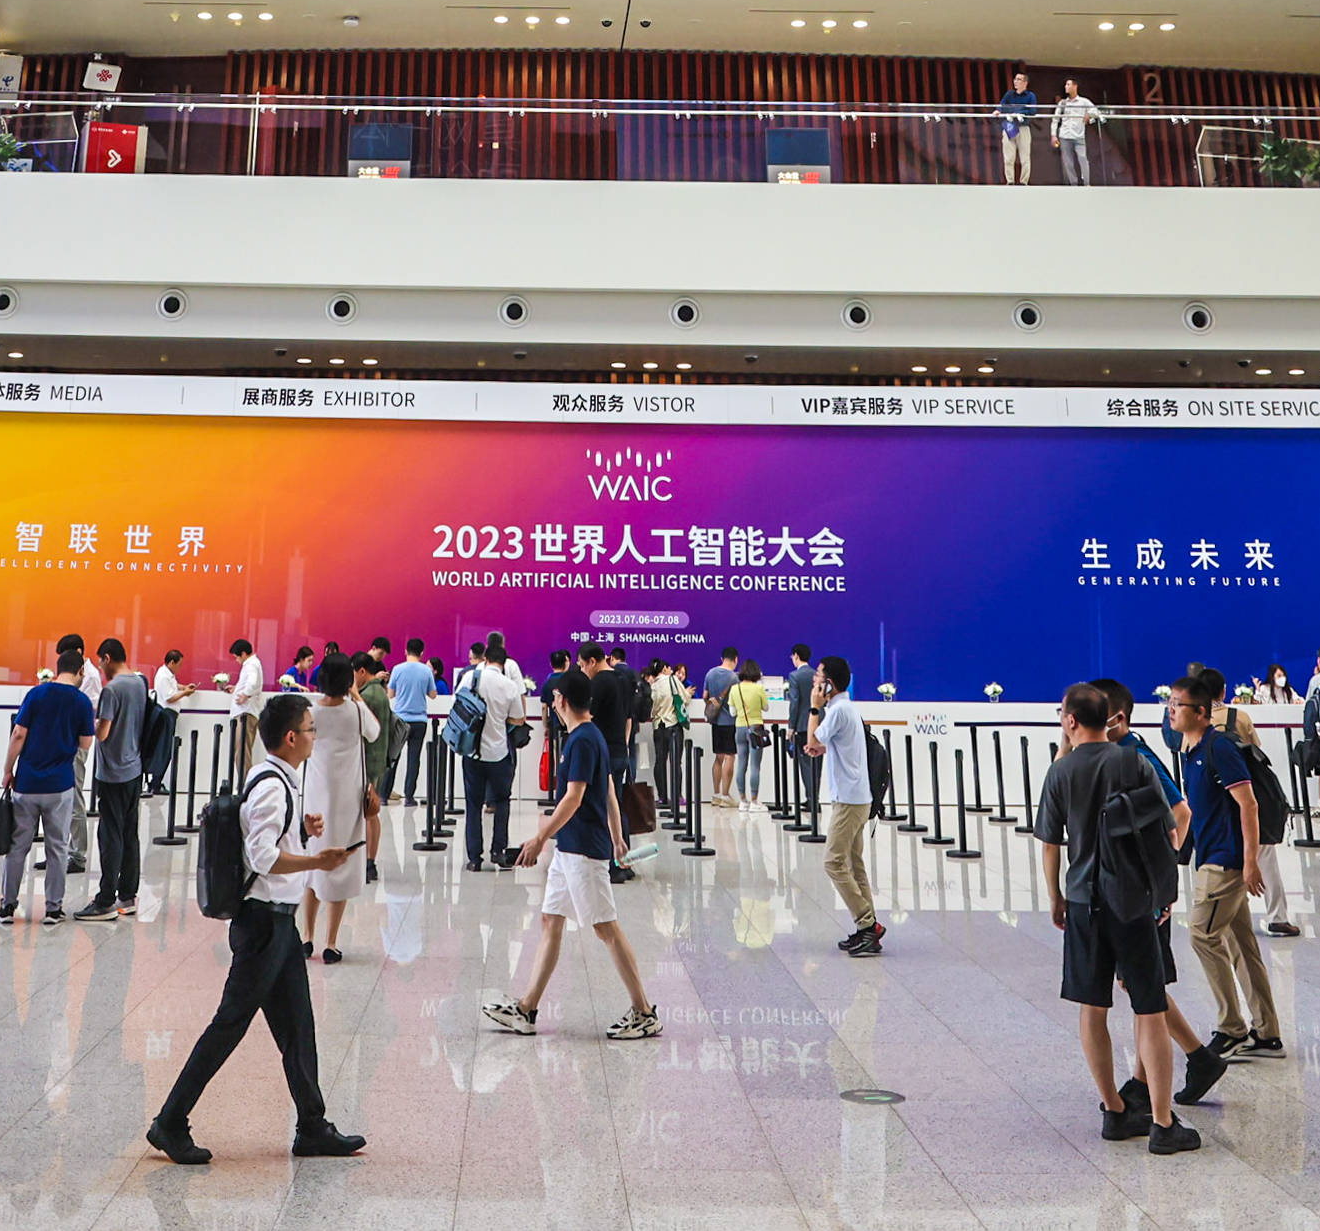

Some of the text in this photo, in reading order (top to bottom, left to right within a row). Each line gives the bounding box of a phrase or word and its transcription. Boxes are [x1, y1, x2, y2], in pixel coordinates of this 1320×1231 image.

[49, 385, 104, 402] MEDIA
[242, 386, 416, 409] 展商服务 EXHIBITOR
[552, 392, 696, 414] 观众服务 VISTOR
[801, 396, 1016, 417] VIP嘉宾服务 VIP SERVICE
[1107, 398, 1180, 418] 综合服务
[1187, 400, 1216, 417] ON
[1219, 400, 1257, 417] SITE
[587, 475, 673, 502] WAIC
[15, 521, 206, 557] 智联世界
[432, 523, 845, 568] 2023世界人工智能大会
[1081, 538, 1275, 571] 生成未来
[104, 562, 245, 574] CONNECTIVITY
[432, 570, 846, 592] WORLD ARTIFICIAL INTELLIGENCE CONFERENCE
[1078, 575, 1281, 587] GENERATING FUTURE
[599, 614, 680, 625] 2023.07.06-07.08
[570, 631, 706, 644] 中国·上海 SHANGHAI·CHINA
[914, 723, 948, 736] WAIC
